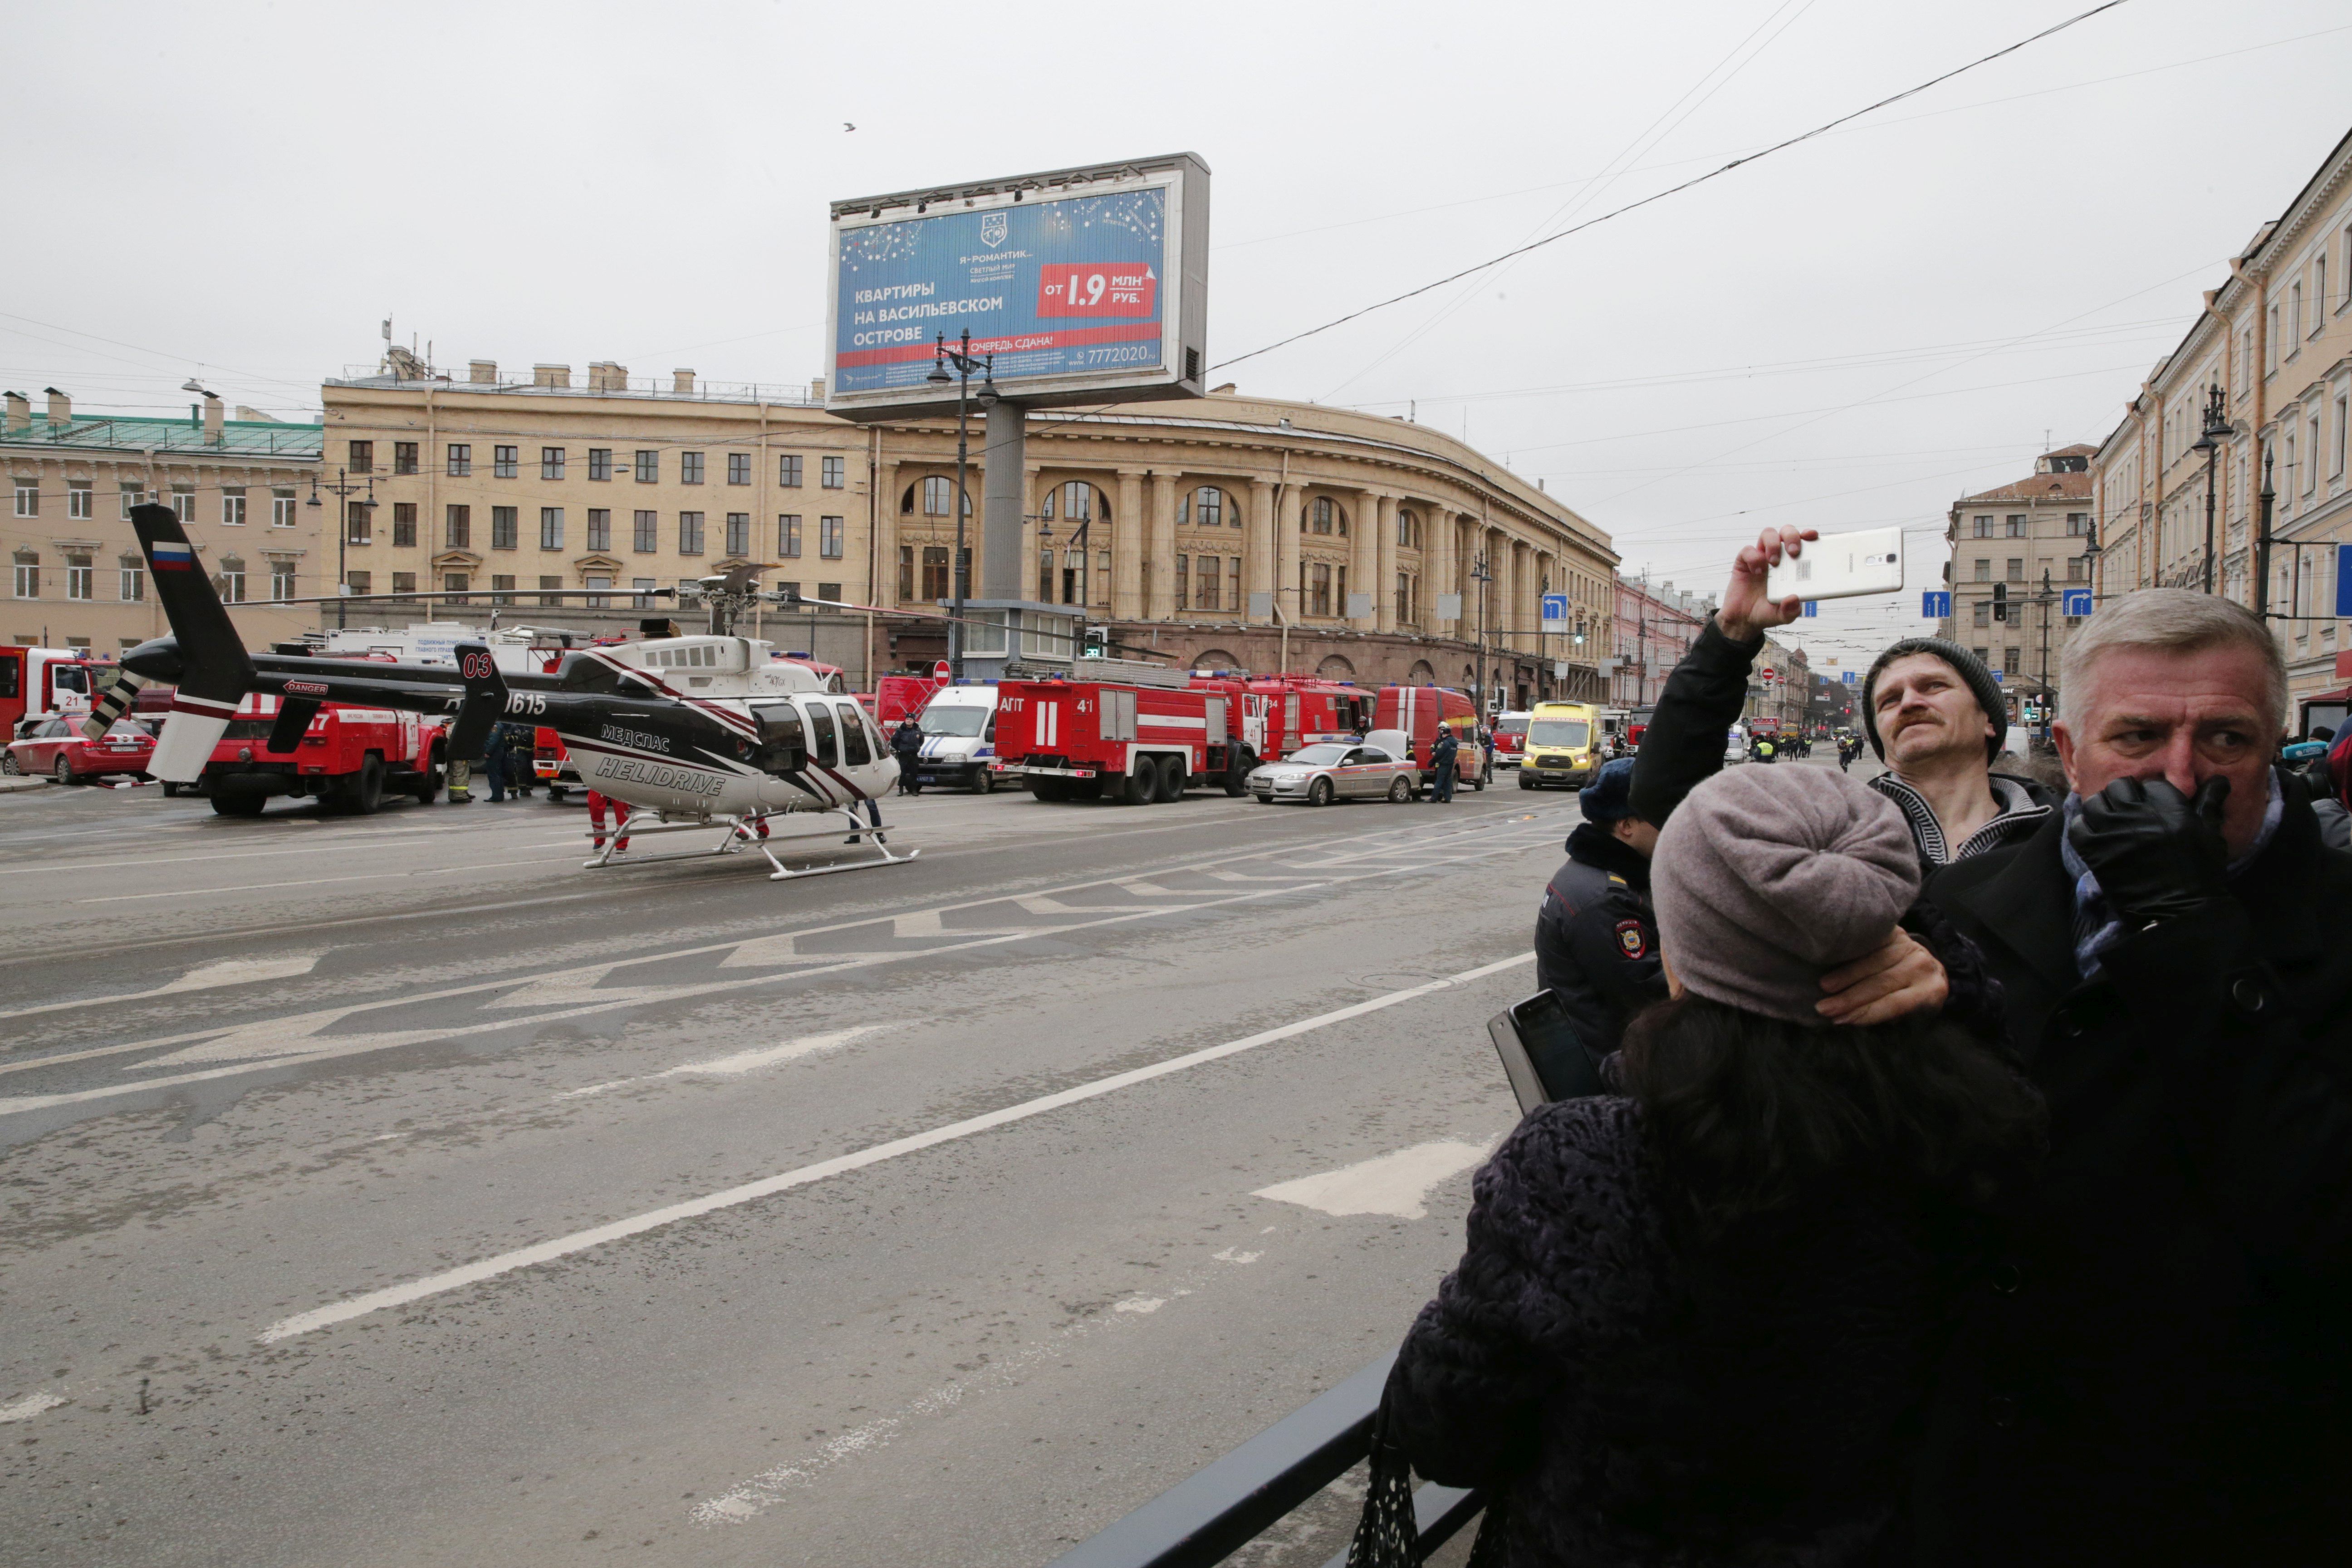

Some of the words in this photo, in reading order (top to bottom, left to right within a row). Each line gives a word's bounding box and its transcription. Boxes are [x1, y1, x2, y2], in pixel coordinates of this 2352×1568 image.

[970, 265, 1000, 274] СВЕТЛЫЙ
[855, 282, 935, 304] КВАРТИРЫ
[1112, 293, 1140, 303] РУБ.
[854, 310, 876, 325] НА
[879, 296, 1003, 323] ВАСИЛЬЕВСКОМ
[934, 344, 962, 355] ПЕРВА
[970, 340, 1013, 352] ОЧЕРЕДЬ
[1015, 336, 1053, 350] СДАНА!
[463, 653, 493, 679] 03
[289, 684, 326, 693] DANGER
[66, 696, 78, 706] 21
[1077, 699, 1093, 712] 41
[1268, 700, 1278, 708] 34
[601, 724, 670, 752] МЕДСПАС
[1250, 729, 1256, 739] 41
[595, 757, 726, 796] HELIDRIVE
